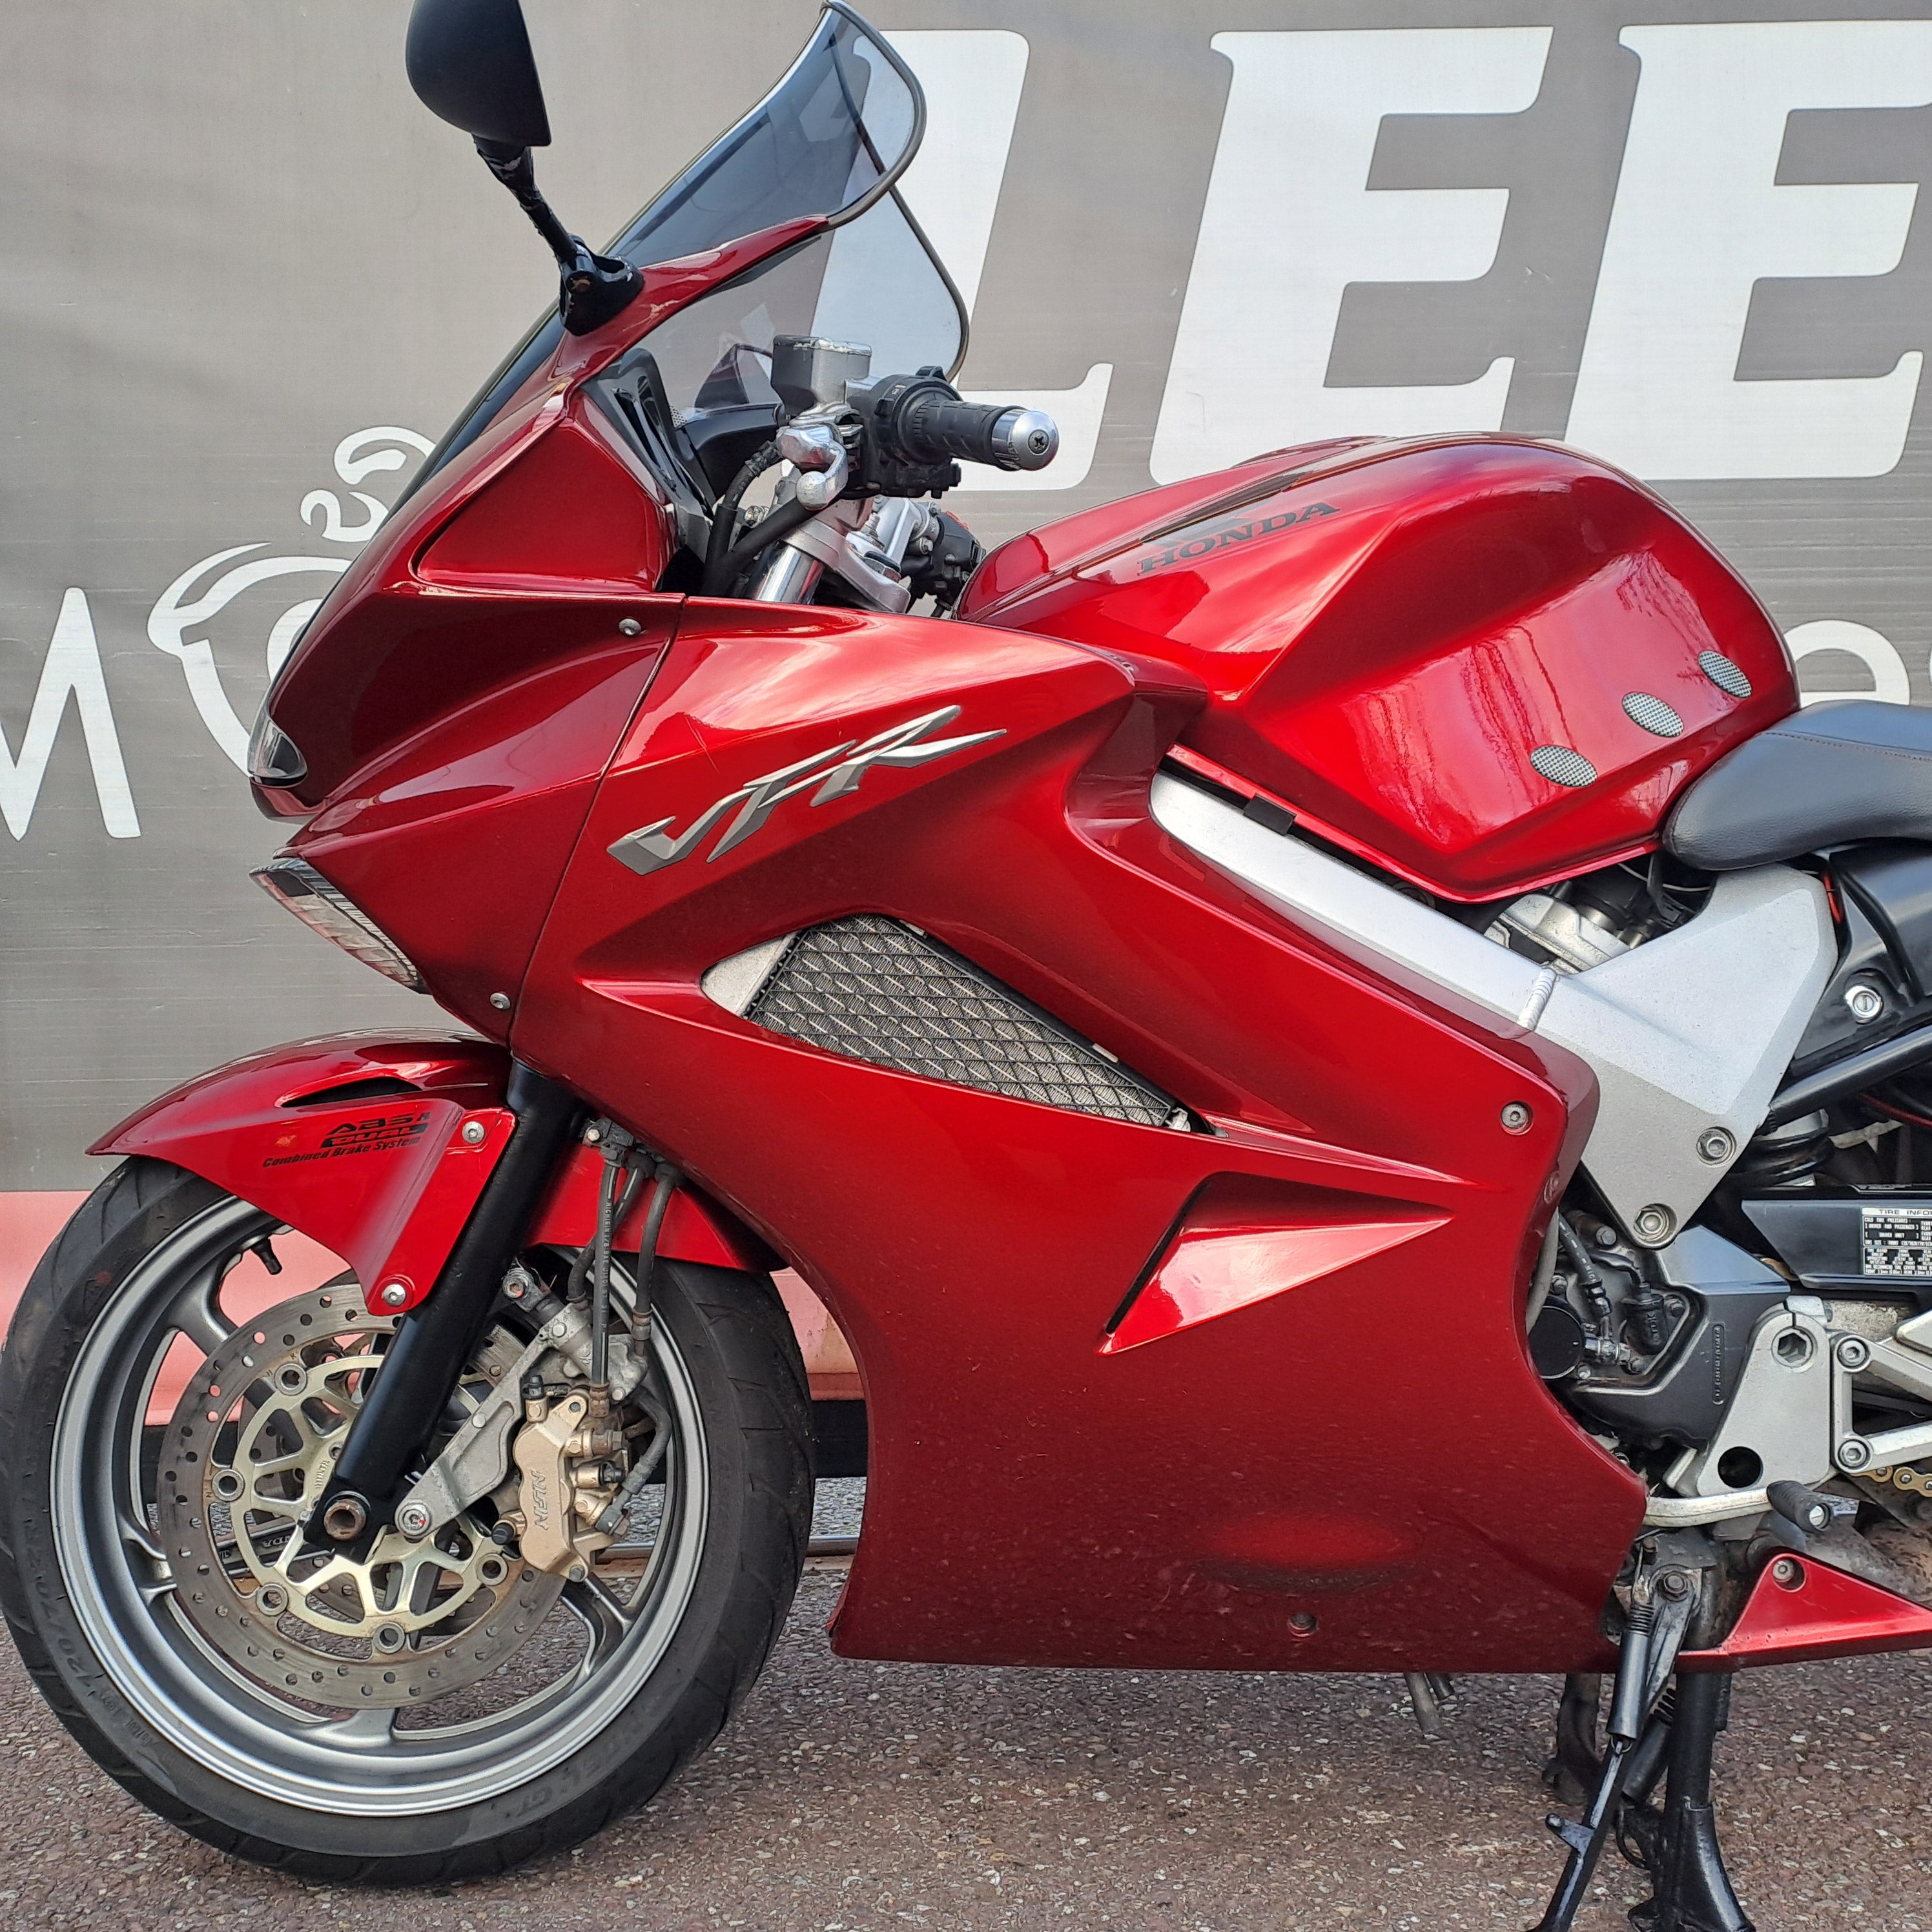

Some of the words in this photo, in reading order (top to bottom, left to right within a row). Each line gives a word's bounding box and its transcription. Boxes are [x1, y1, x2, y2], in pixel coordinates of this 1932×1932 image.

[1137, 502, 1341, 576] HONDA
[606, 704, 1007, 876] VFR
[327, 1113, 415, 1135] ABS
[262, 1149, 331, 1167] Combined
[331, 1144, 370, 1158] Brake
[374, 1136, 421, 1152] System
